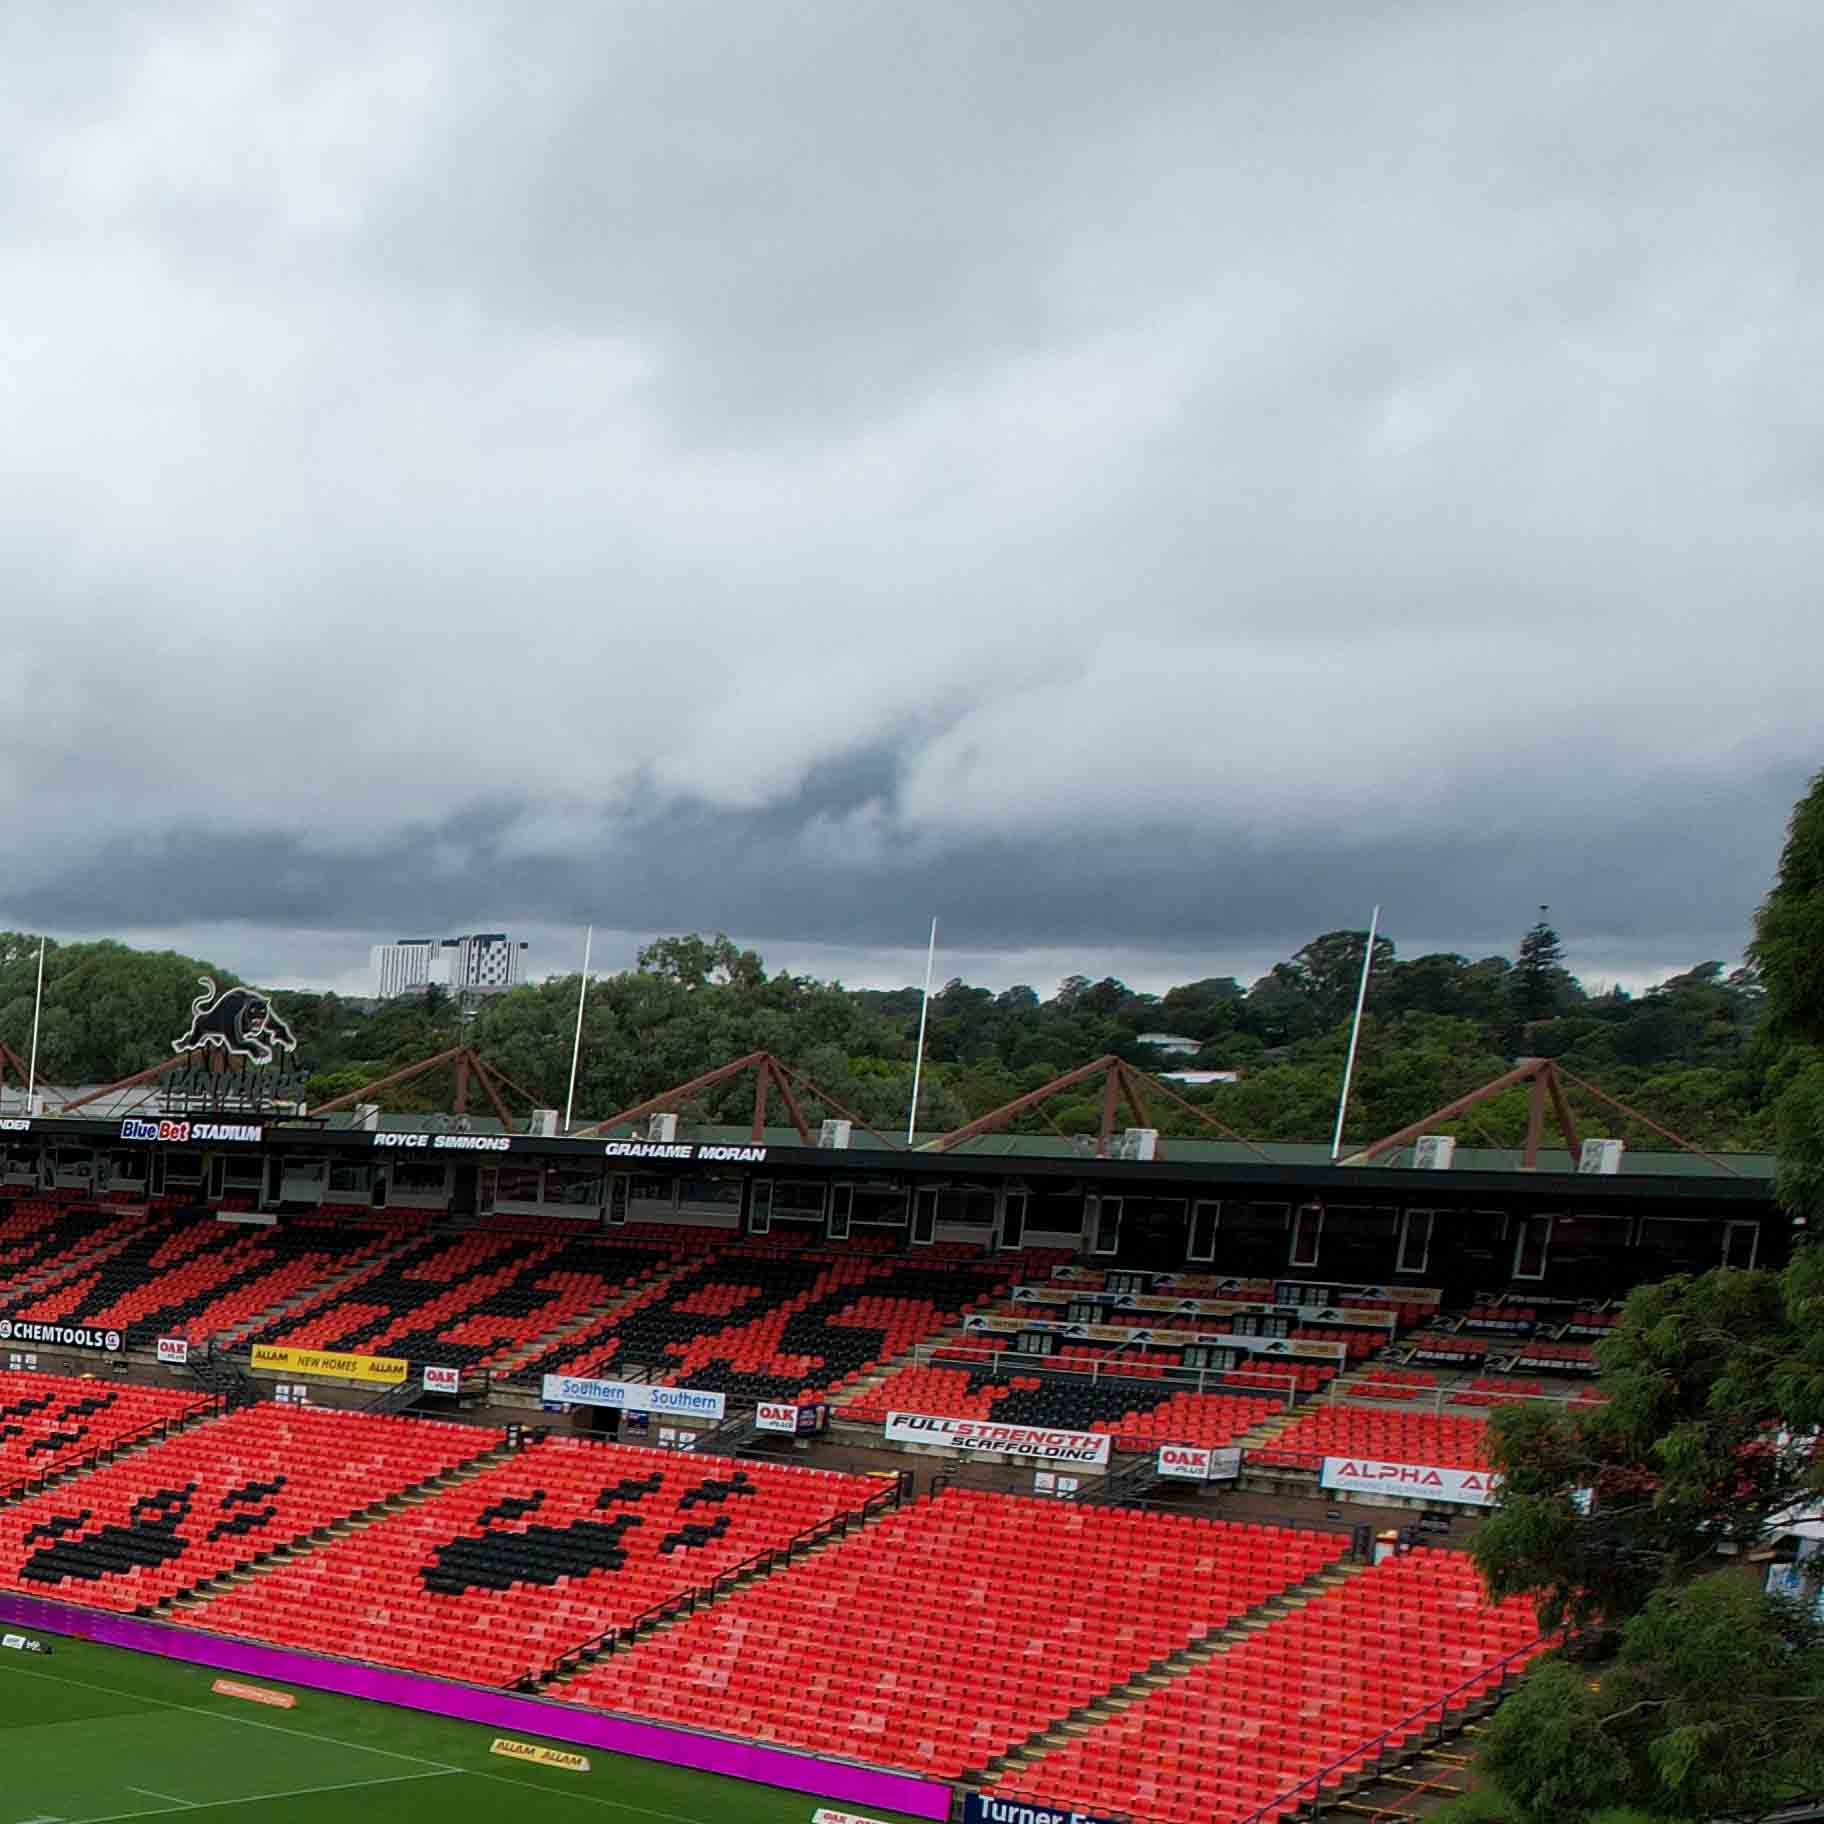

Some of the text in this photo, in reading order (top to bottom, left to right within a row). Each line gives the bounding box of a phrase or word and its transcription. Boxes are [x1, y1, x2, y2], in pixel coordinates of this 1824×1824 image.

[191, 1124, 263, 1141] STADIUM
[374, 1133, 511, 1151] ROYCE SIMMONS
[605, 1143, 766, 1162] GRAHAME MORAN
[13, 1322, 104, 1347] CHEMTOOLS
[159, 1341, 184, 1354] OAK
[255, 1350, 404, 1375] ALLAM NEW HOMES ALLAM
[426, 1368, 456, 1383] OAK
[562, 1379, 717, 1410] Southern Southern
[758, 1405, 795, 1421] OAK
[951, 1436, 1096, 1461] SCAFFOLDING
[1162, 1450, 1206, 1466] OAK
[1175, 1466, 1206, 1475] PLUS
[1338, 1461, 1443, 1487] ALPHA
[495, 1741, 582, 1767] ALLAM ALLAM
